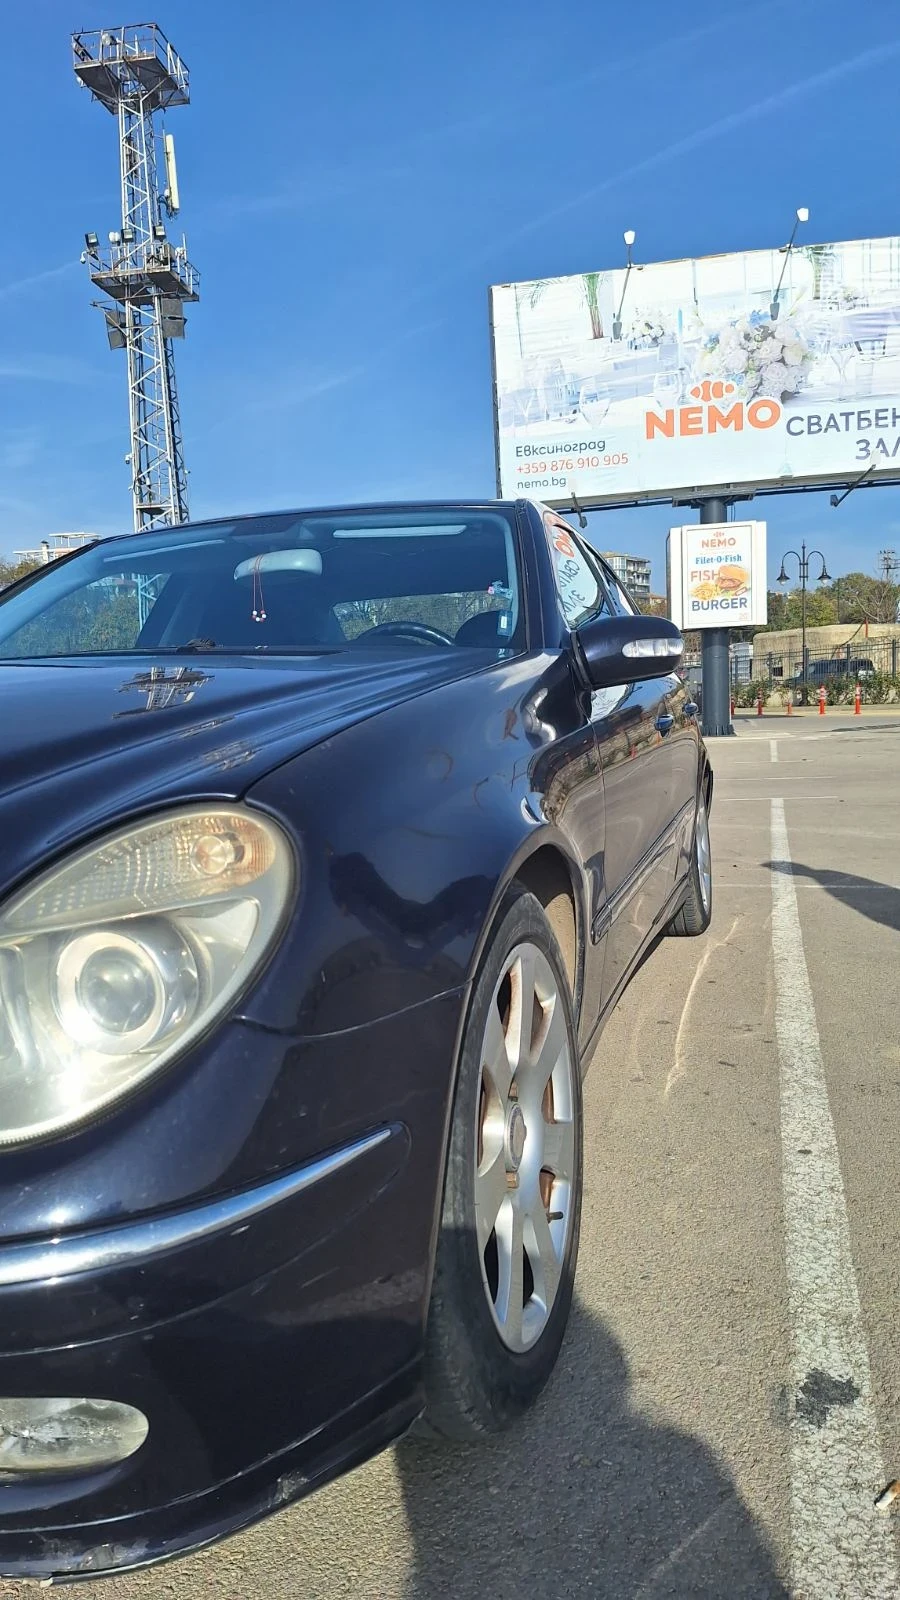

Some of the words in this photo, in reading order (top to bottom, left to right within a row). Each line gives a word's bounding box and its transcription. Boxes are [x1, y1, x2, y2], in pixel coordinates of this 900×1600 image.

[645, 399, 781, 440] NEMO
[515, 440, 606, 457] Евксиноград
[517, 461, 547, 474] +359
[550, 459, 574, 472] 876
[577, 456, 599, 469] 910
[603, 453, 629, 466] 905
[517, 477, 567, 489] nemo.bg
[701, 537, 737, 548] NEMO
[690, 569, 721, 582] FISH
[691, 597, 748, 611] BURGER
